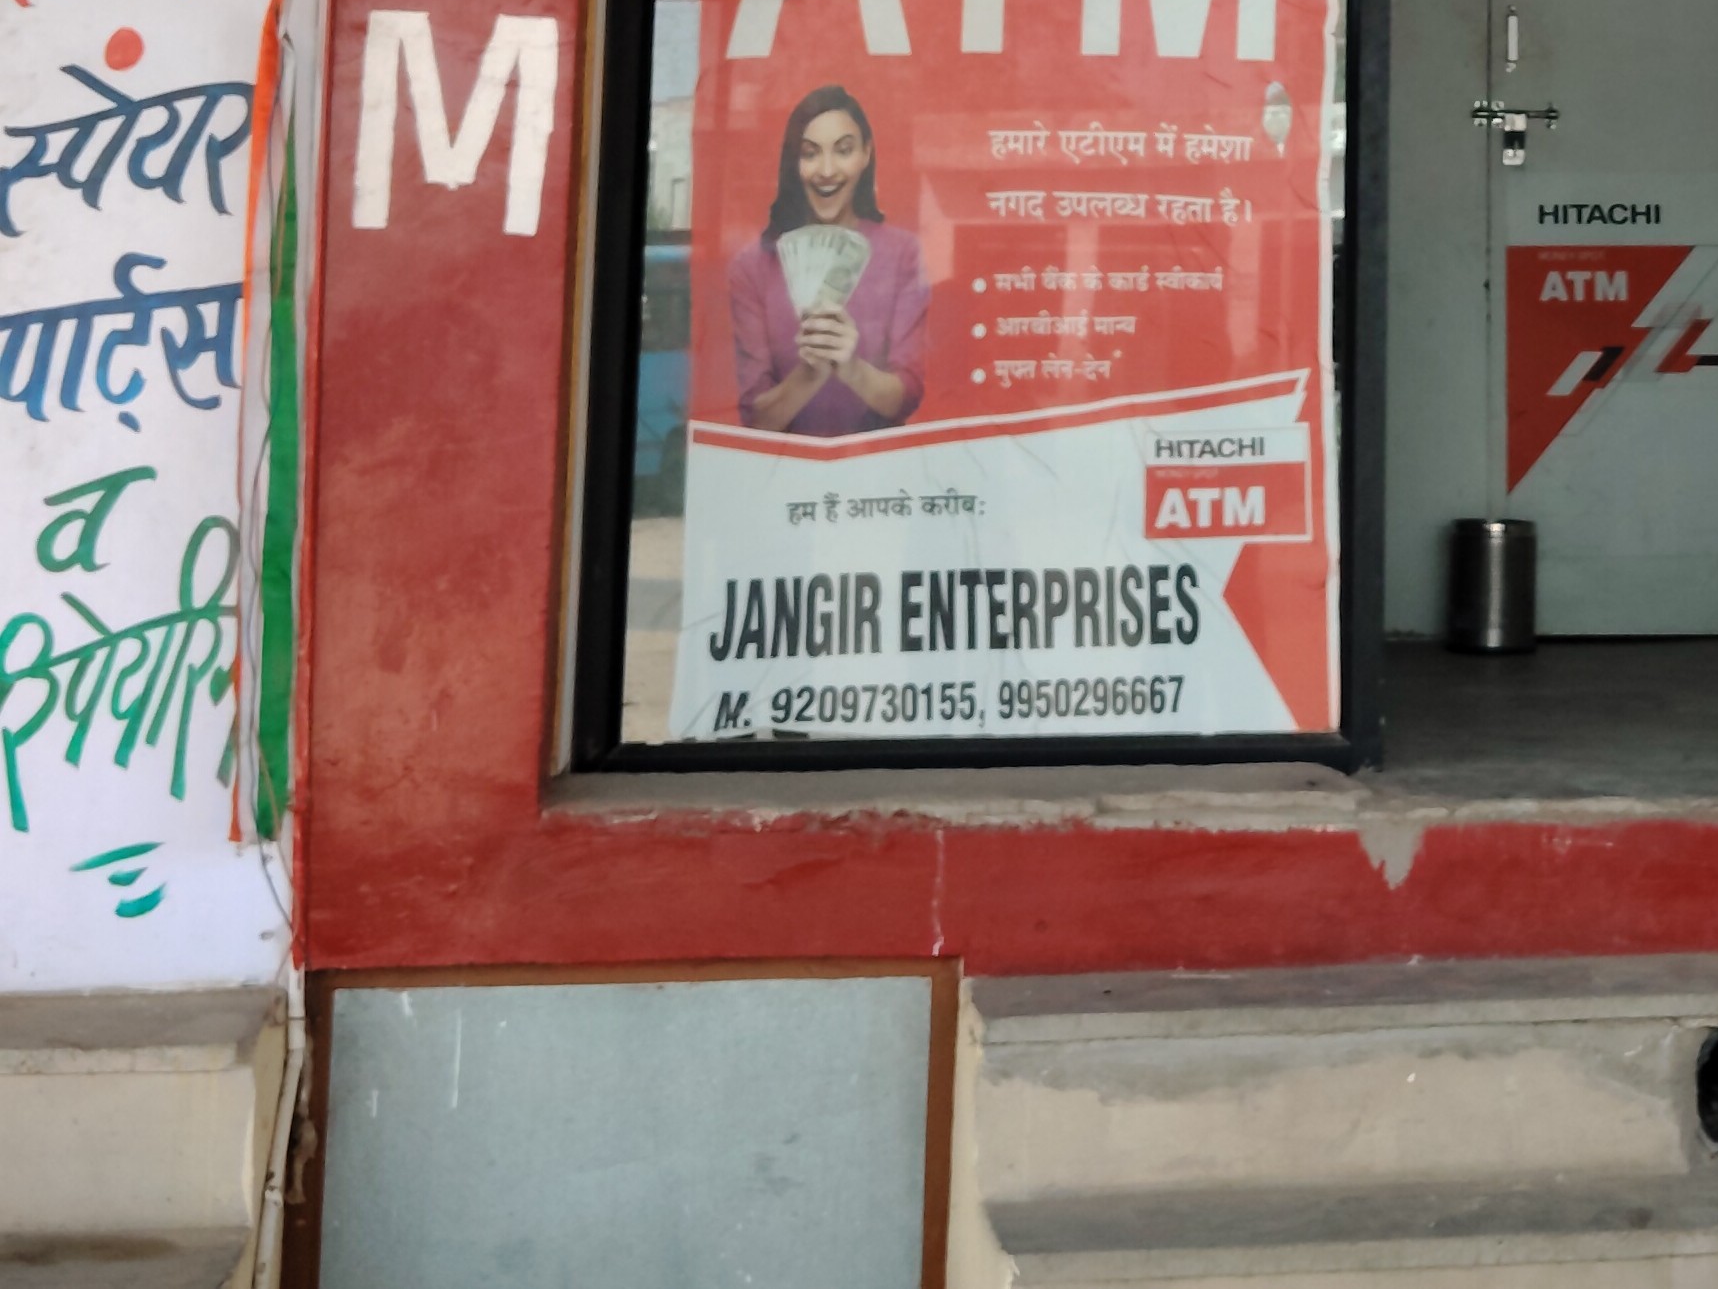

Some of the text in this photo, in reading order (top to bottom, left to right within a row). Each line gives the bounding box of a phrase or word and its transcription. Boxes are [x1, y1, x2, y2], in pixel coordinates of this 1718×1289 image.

[988, 120, 1254, 165] हमारे एटीएम में हमेशा
[986, 190, 1047, 221] नगद
[1053, 191, 1149, 219] उपलब्ध
[1155, 194, 1213, 224] रहता
[1538, 204, 1662, 225] HITACHI
[1539, 270, 1630, 303] ATM
[1154, 436, 1266, 459] HITACHI
[37, 466, 157, 573] व
[785, 501, 818, 525] हम
[822, 491, 841, 523] हैं
[847, 488, 914, 518] आपके
[1154, 485, 1266, 530] ATM
[709, 564, 1199, 661] JANGIR ENTERPRISES
[999, 675, 1185, 720] 9950296667
